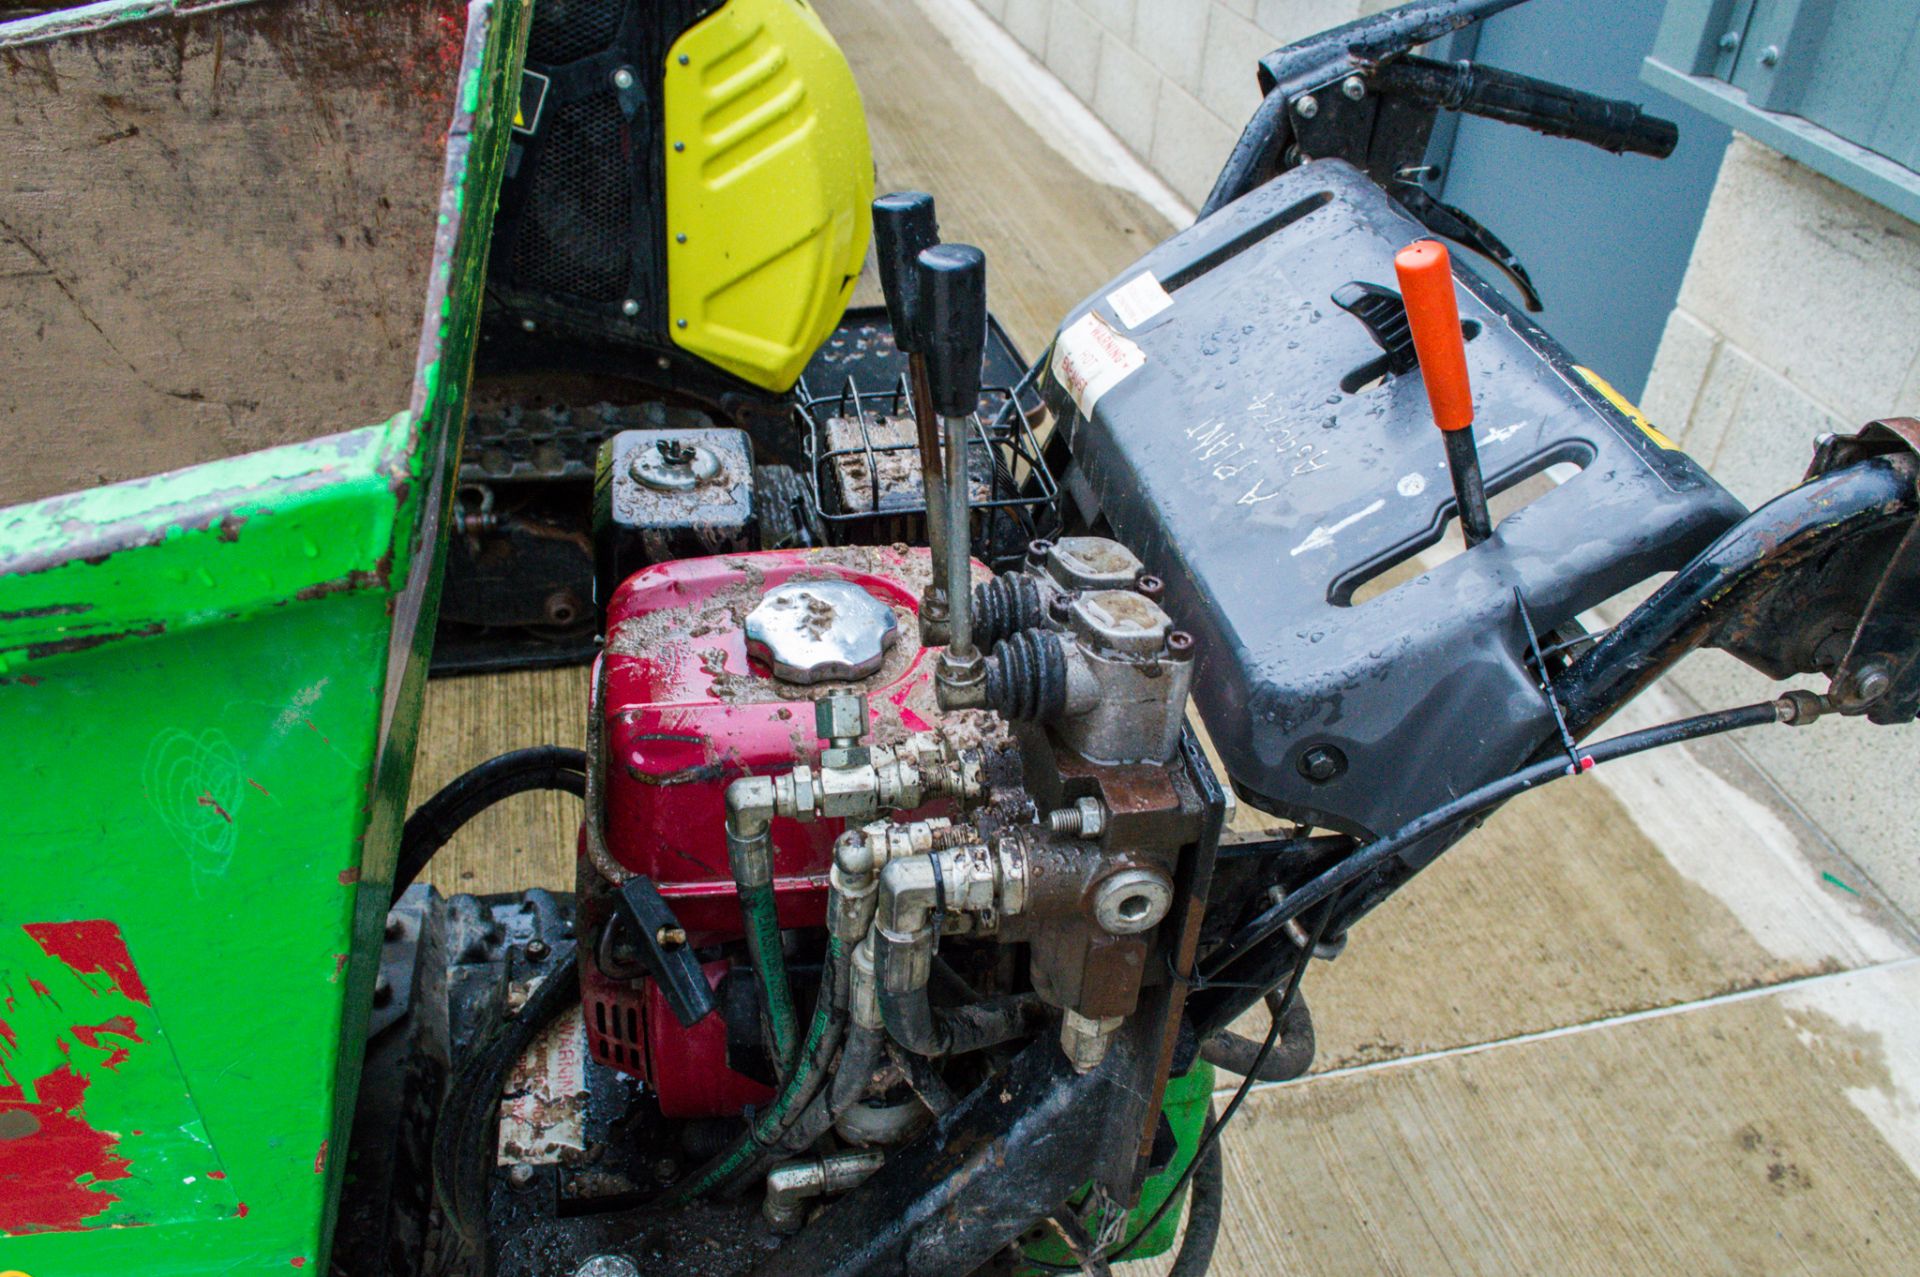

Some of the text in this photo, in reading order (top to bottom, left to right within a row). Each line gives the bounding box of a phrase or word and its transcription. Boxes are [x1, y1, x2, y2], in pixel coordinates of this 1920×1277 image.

[1091, 323, 1126, 363] WARNING
[1184, 418, 1279, 506] A PLANT
